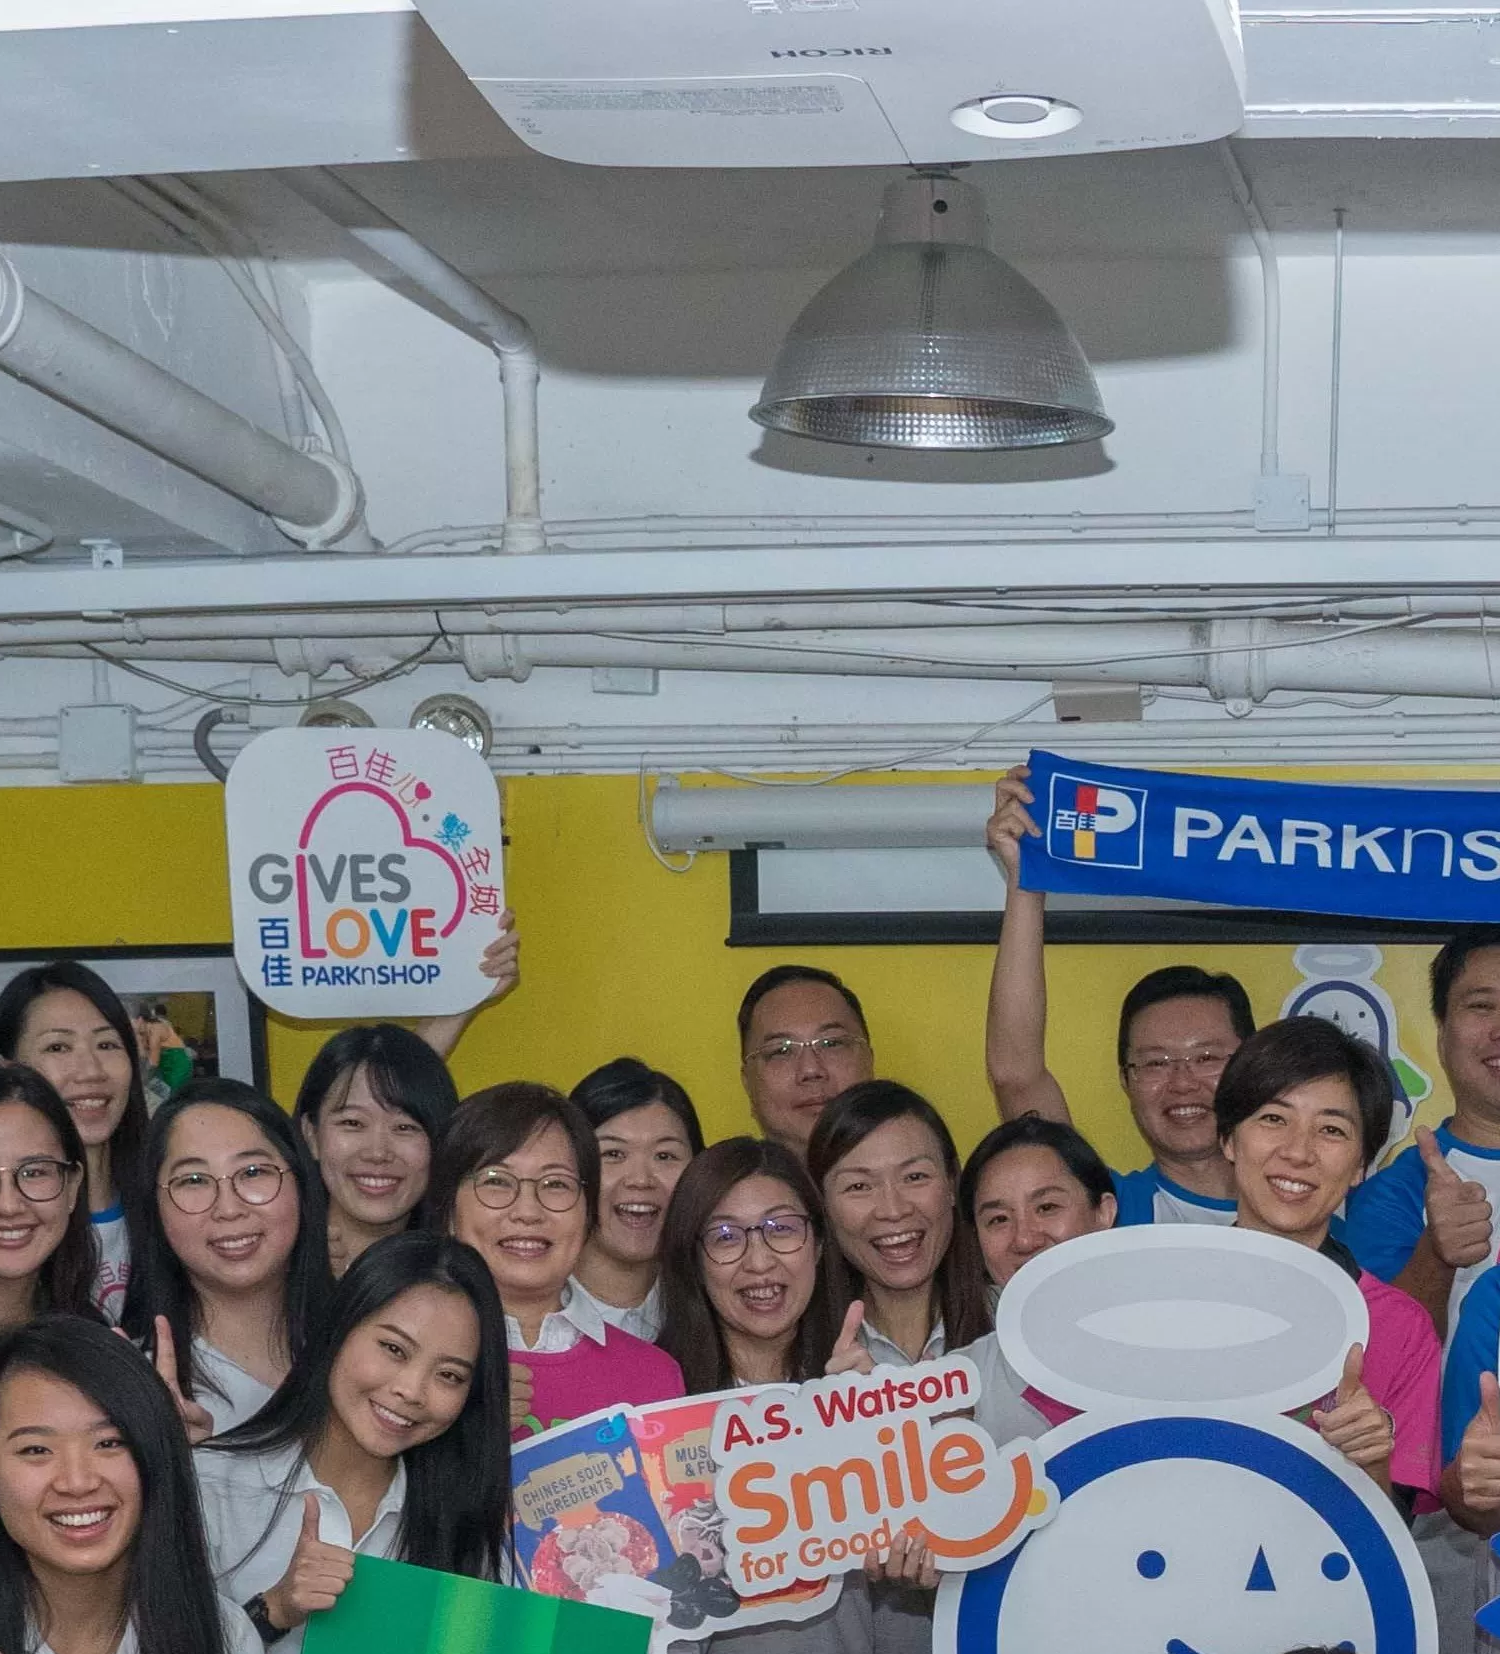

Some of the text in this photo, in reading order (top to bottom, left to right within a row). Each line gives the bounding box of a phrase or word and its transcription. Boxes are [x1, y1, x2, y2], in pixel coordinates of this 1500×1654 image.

[248, 853, 412, 905] GIVES
[258, 917, 294, 987] 百佳
[297, 907, 440, 960] LOVE
[722, 1368, 969, 1452] A.S. Watson
[521, 1460, 610, 1508] CHINESE SOUP
[532, 1476, 615, 1522] INGREDIENTS
[727, 1420, 987, 1544] Smile
[739, 1518, 895, 1584] for Good
